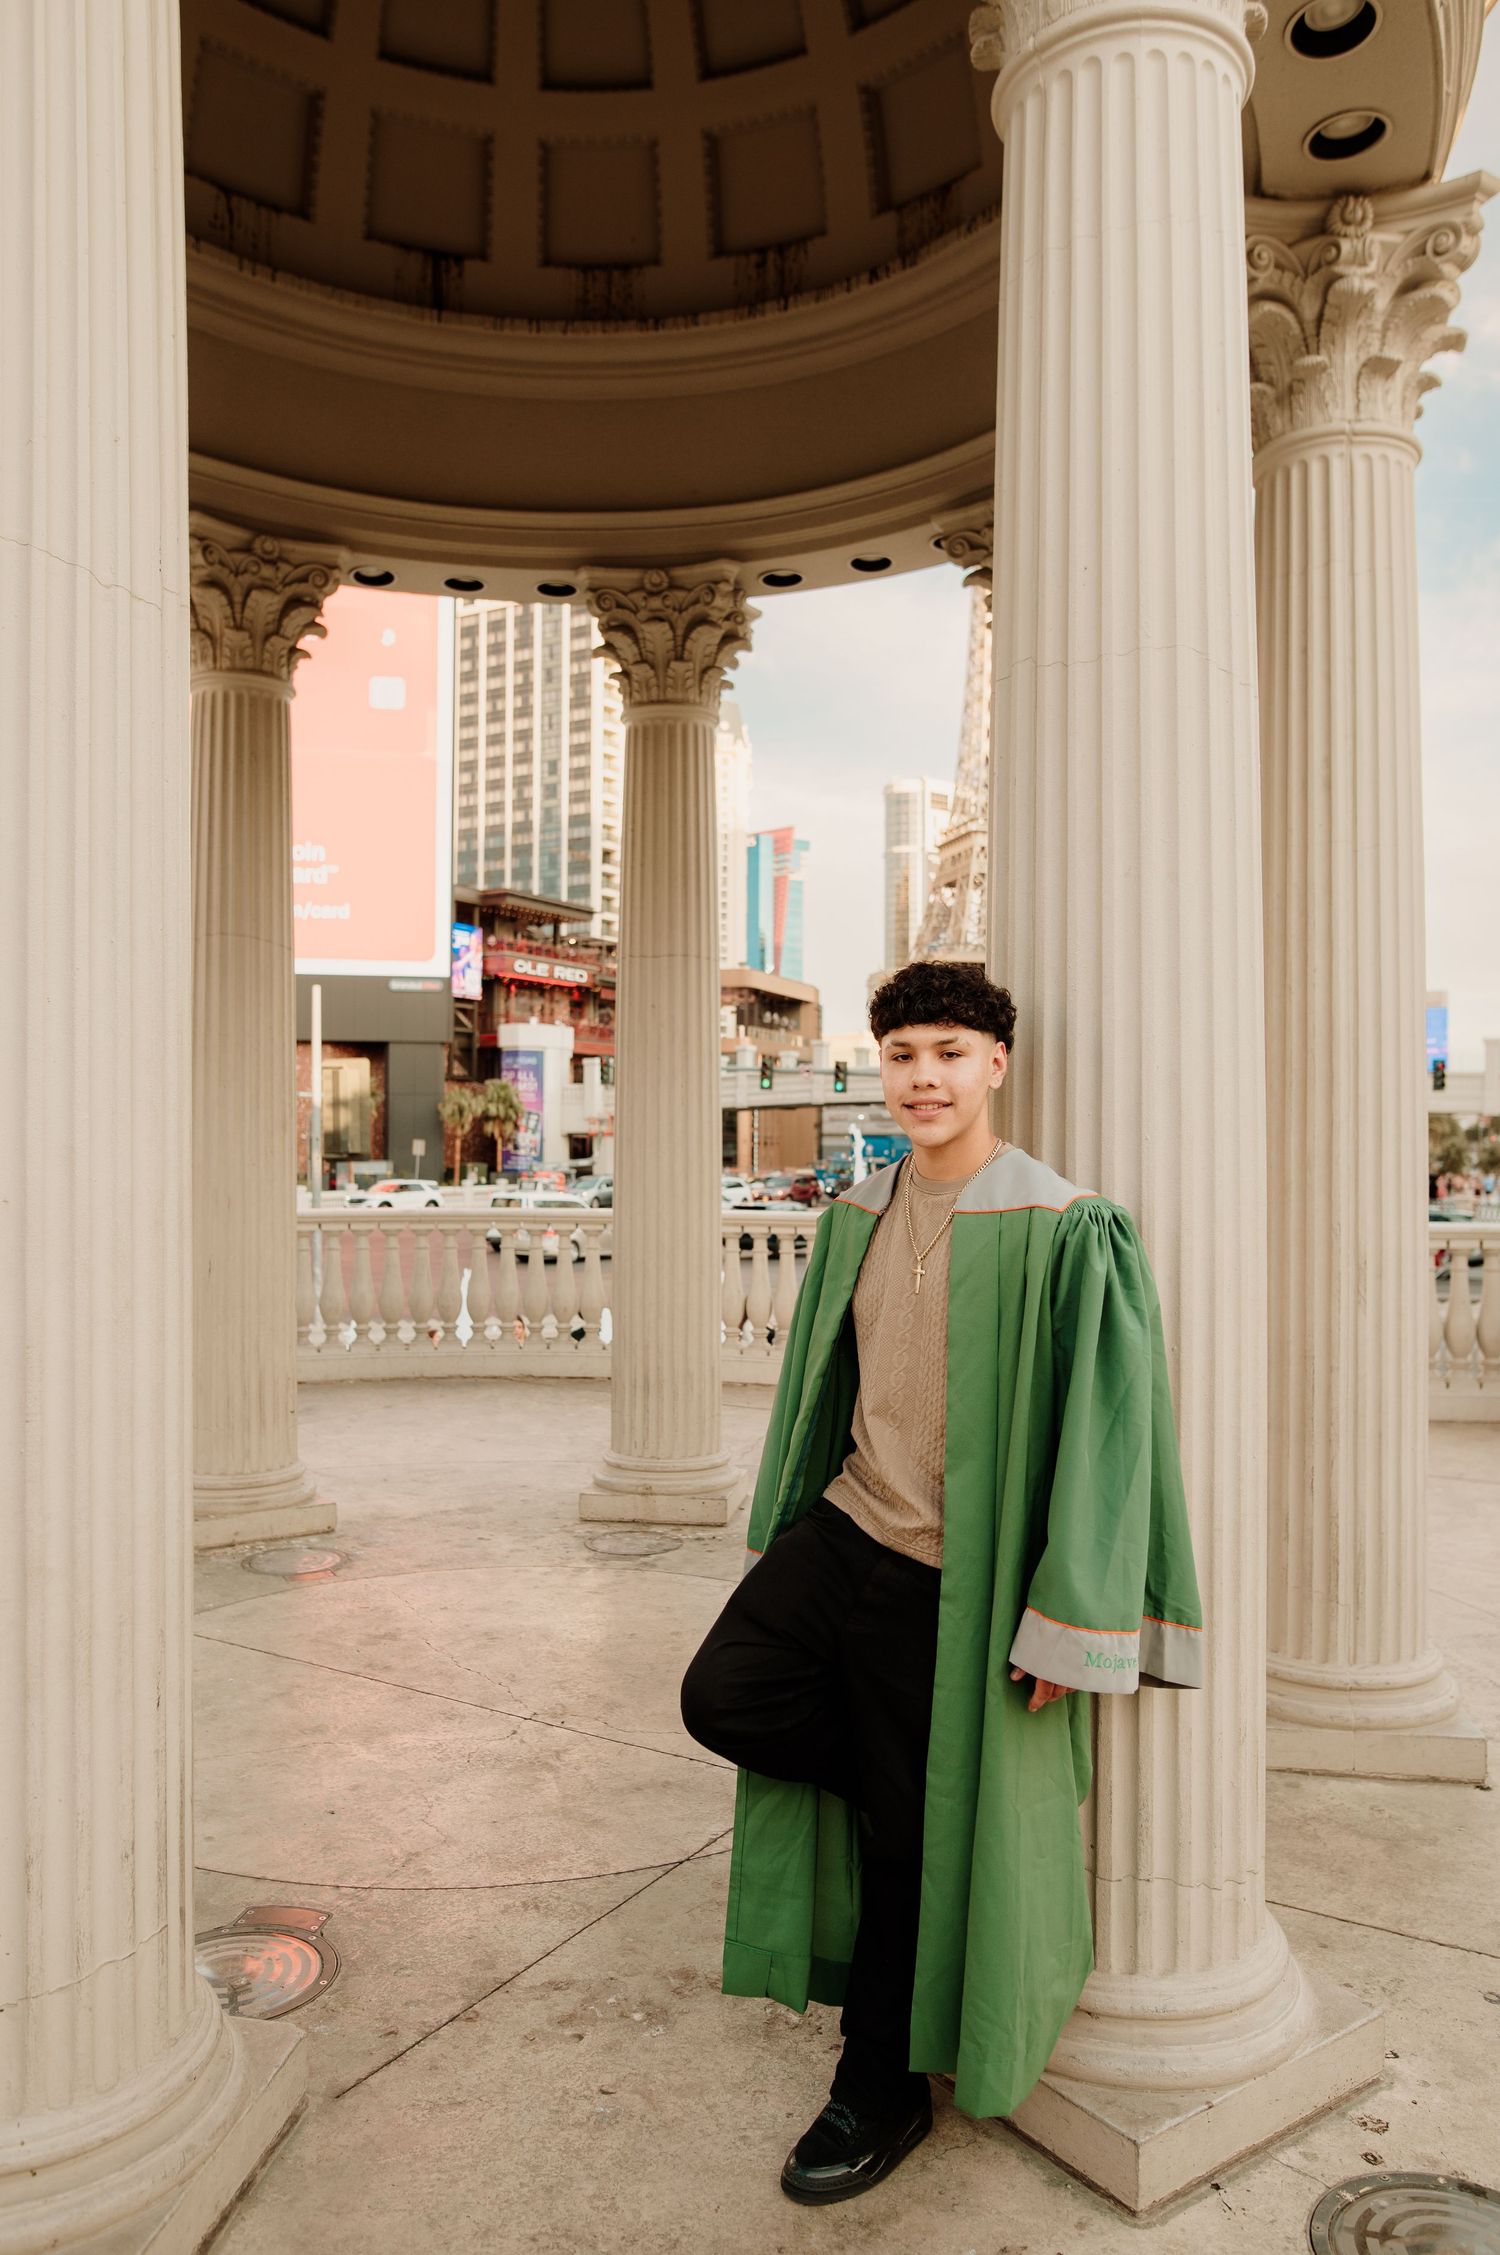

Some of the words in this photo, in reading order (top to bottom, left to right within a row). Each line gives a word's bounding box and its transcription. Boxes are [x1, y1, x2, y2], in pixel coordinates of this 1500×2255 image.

[293, 841, 326, 861] oin
[513, 958, 549, 977] OLE
[553, 965, 588, 983] RED
